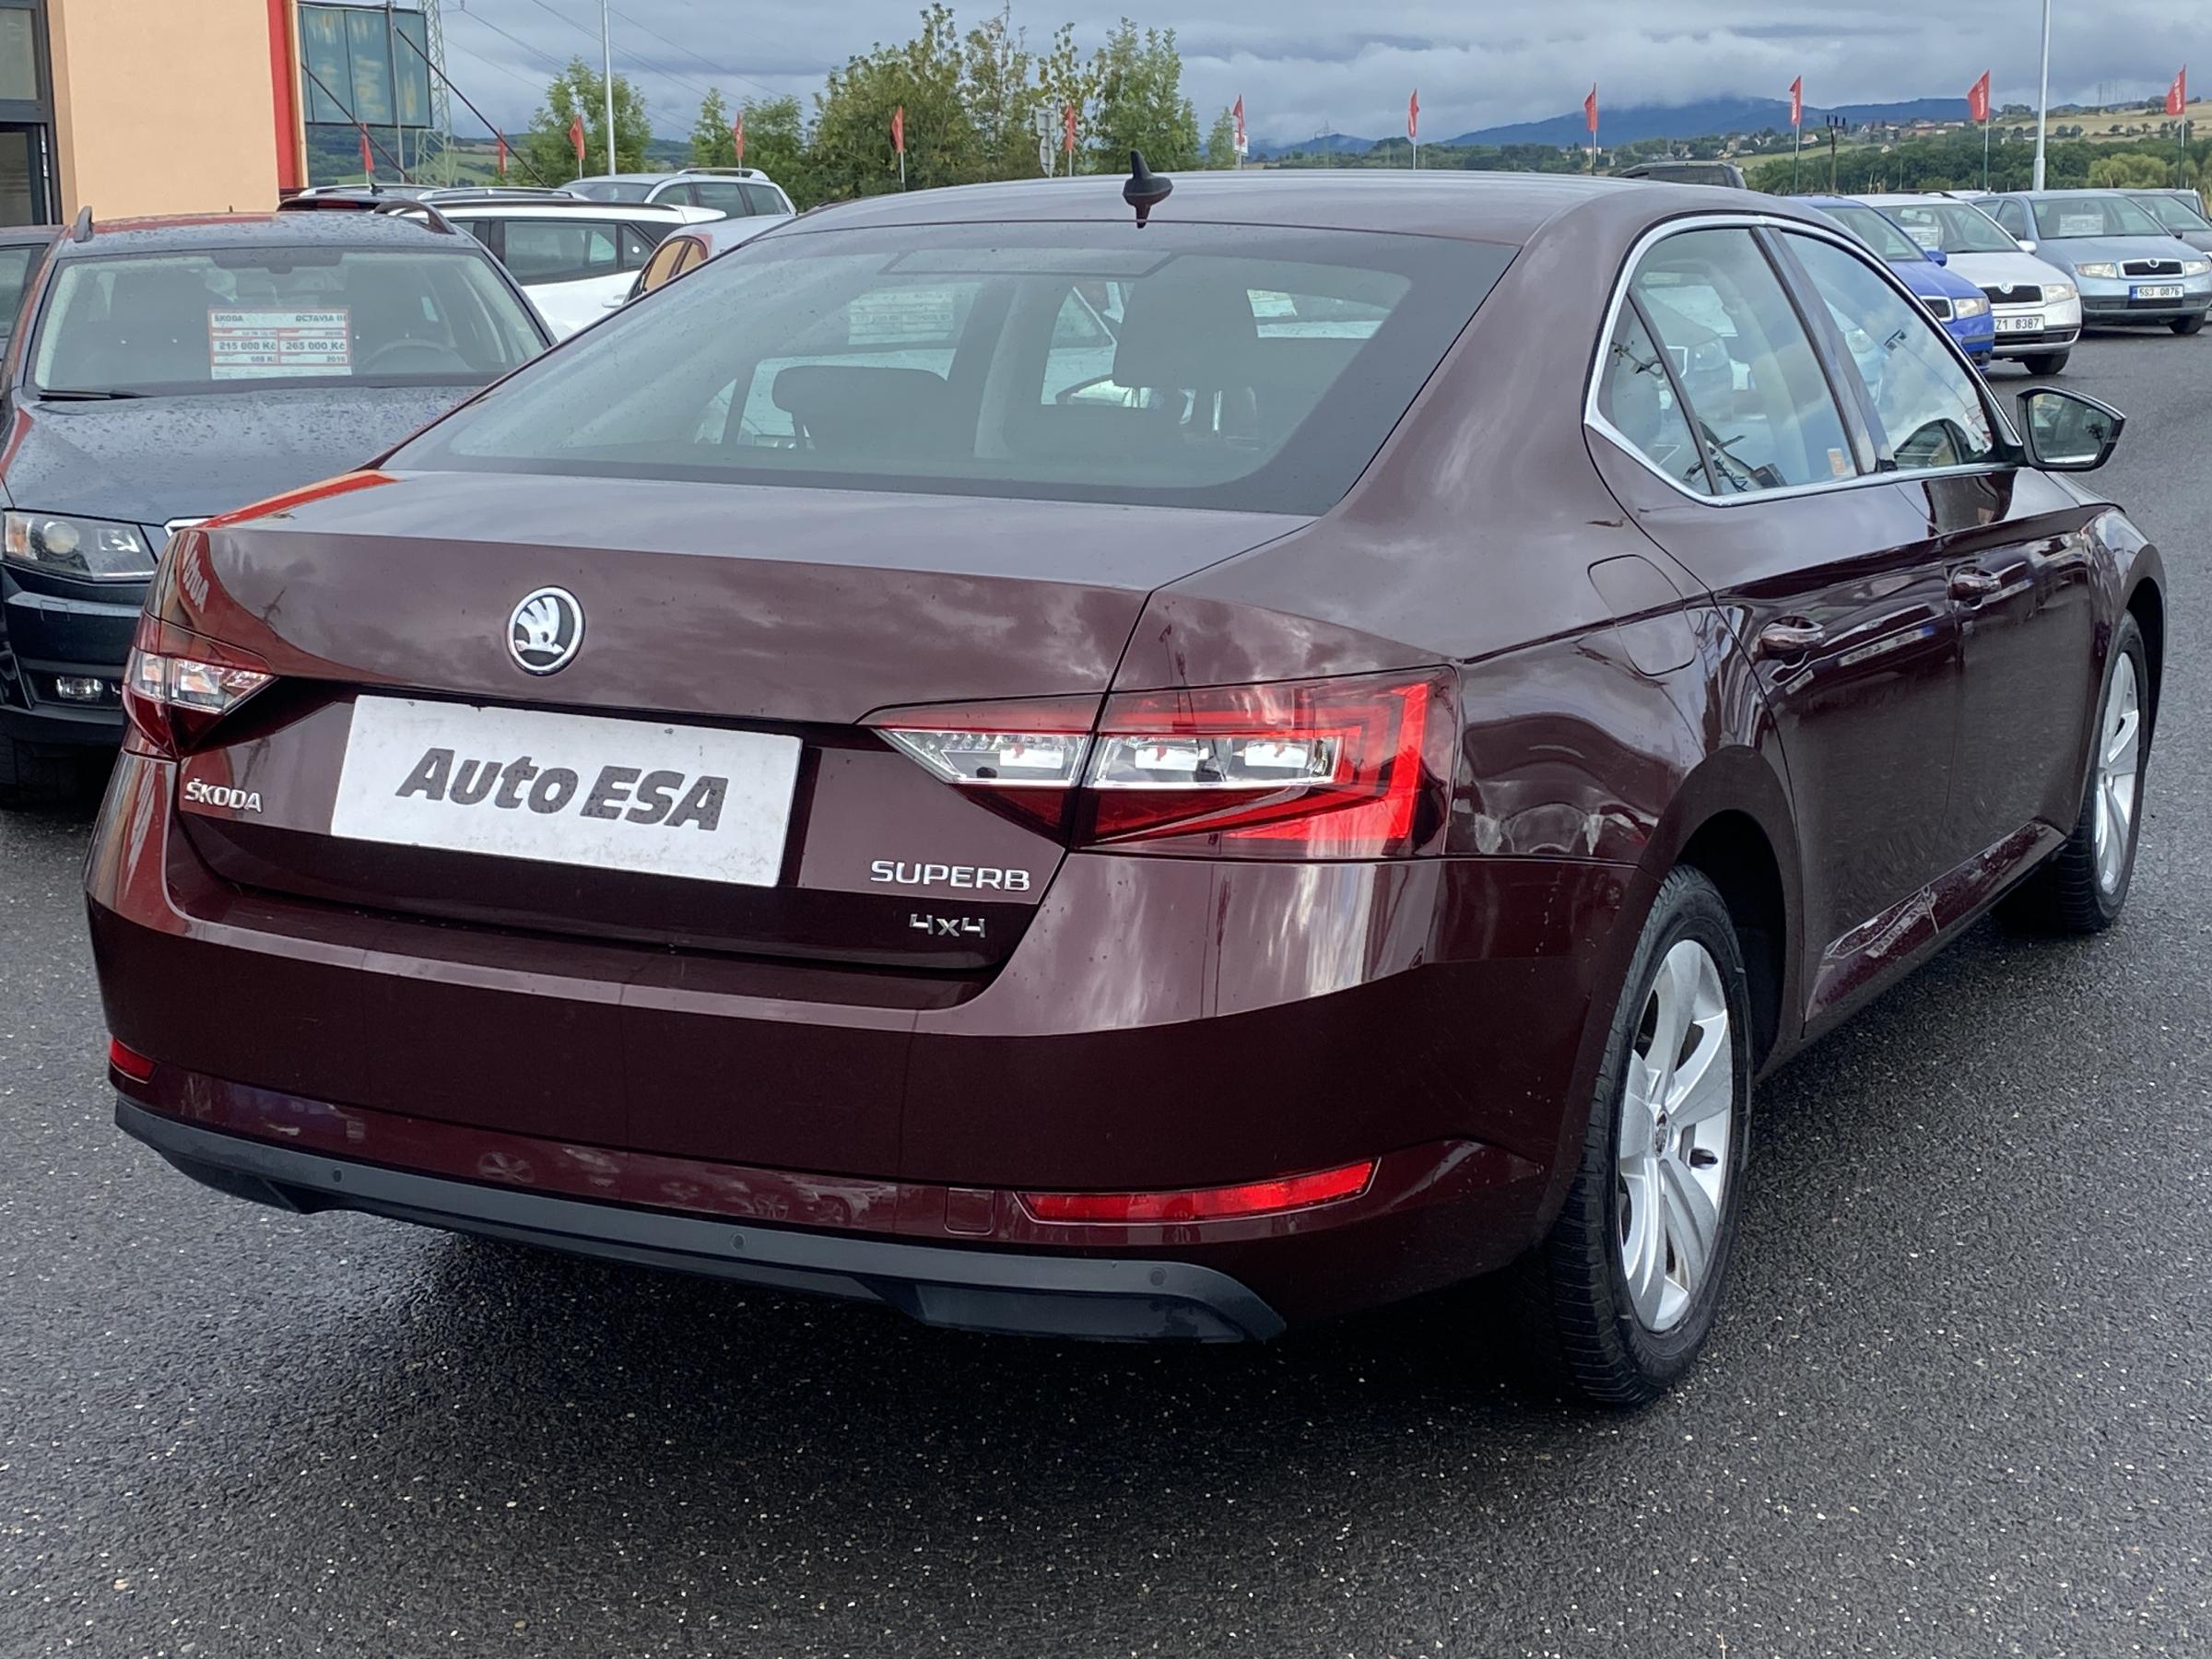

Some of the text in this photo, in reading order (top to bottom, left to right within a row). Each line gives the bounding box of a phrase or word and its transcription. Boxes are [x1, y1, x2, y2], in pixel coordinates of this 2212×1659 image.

[295, 314, 335, 323] OCTAVIA
[184, 777, 263, 813] ŠKODA
[396, 747, 729, 831] Auto ESA
[870, 860, 1031, 891] SUPERB
